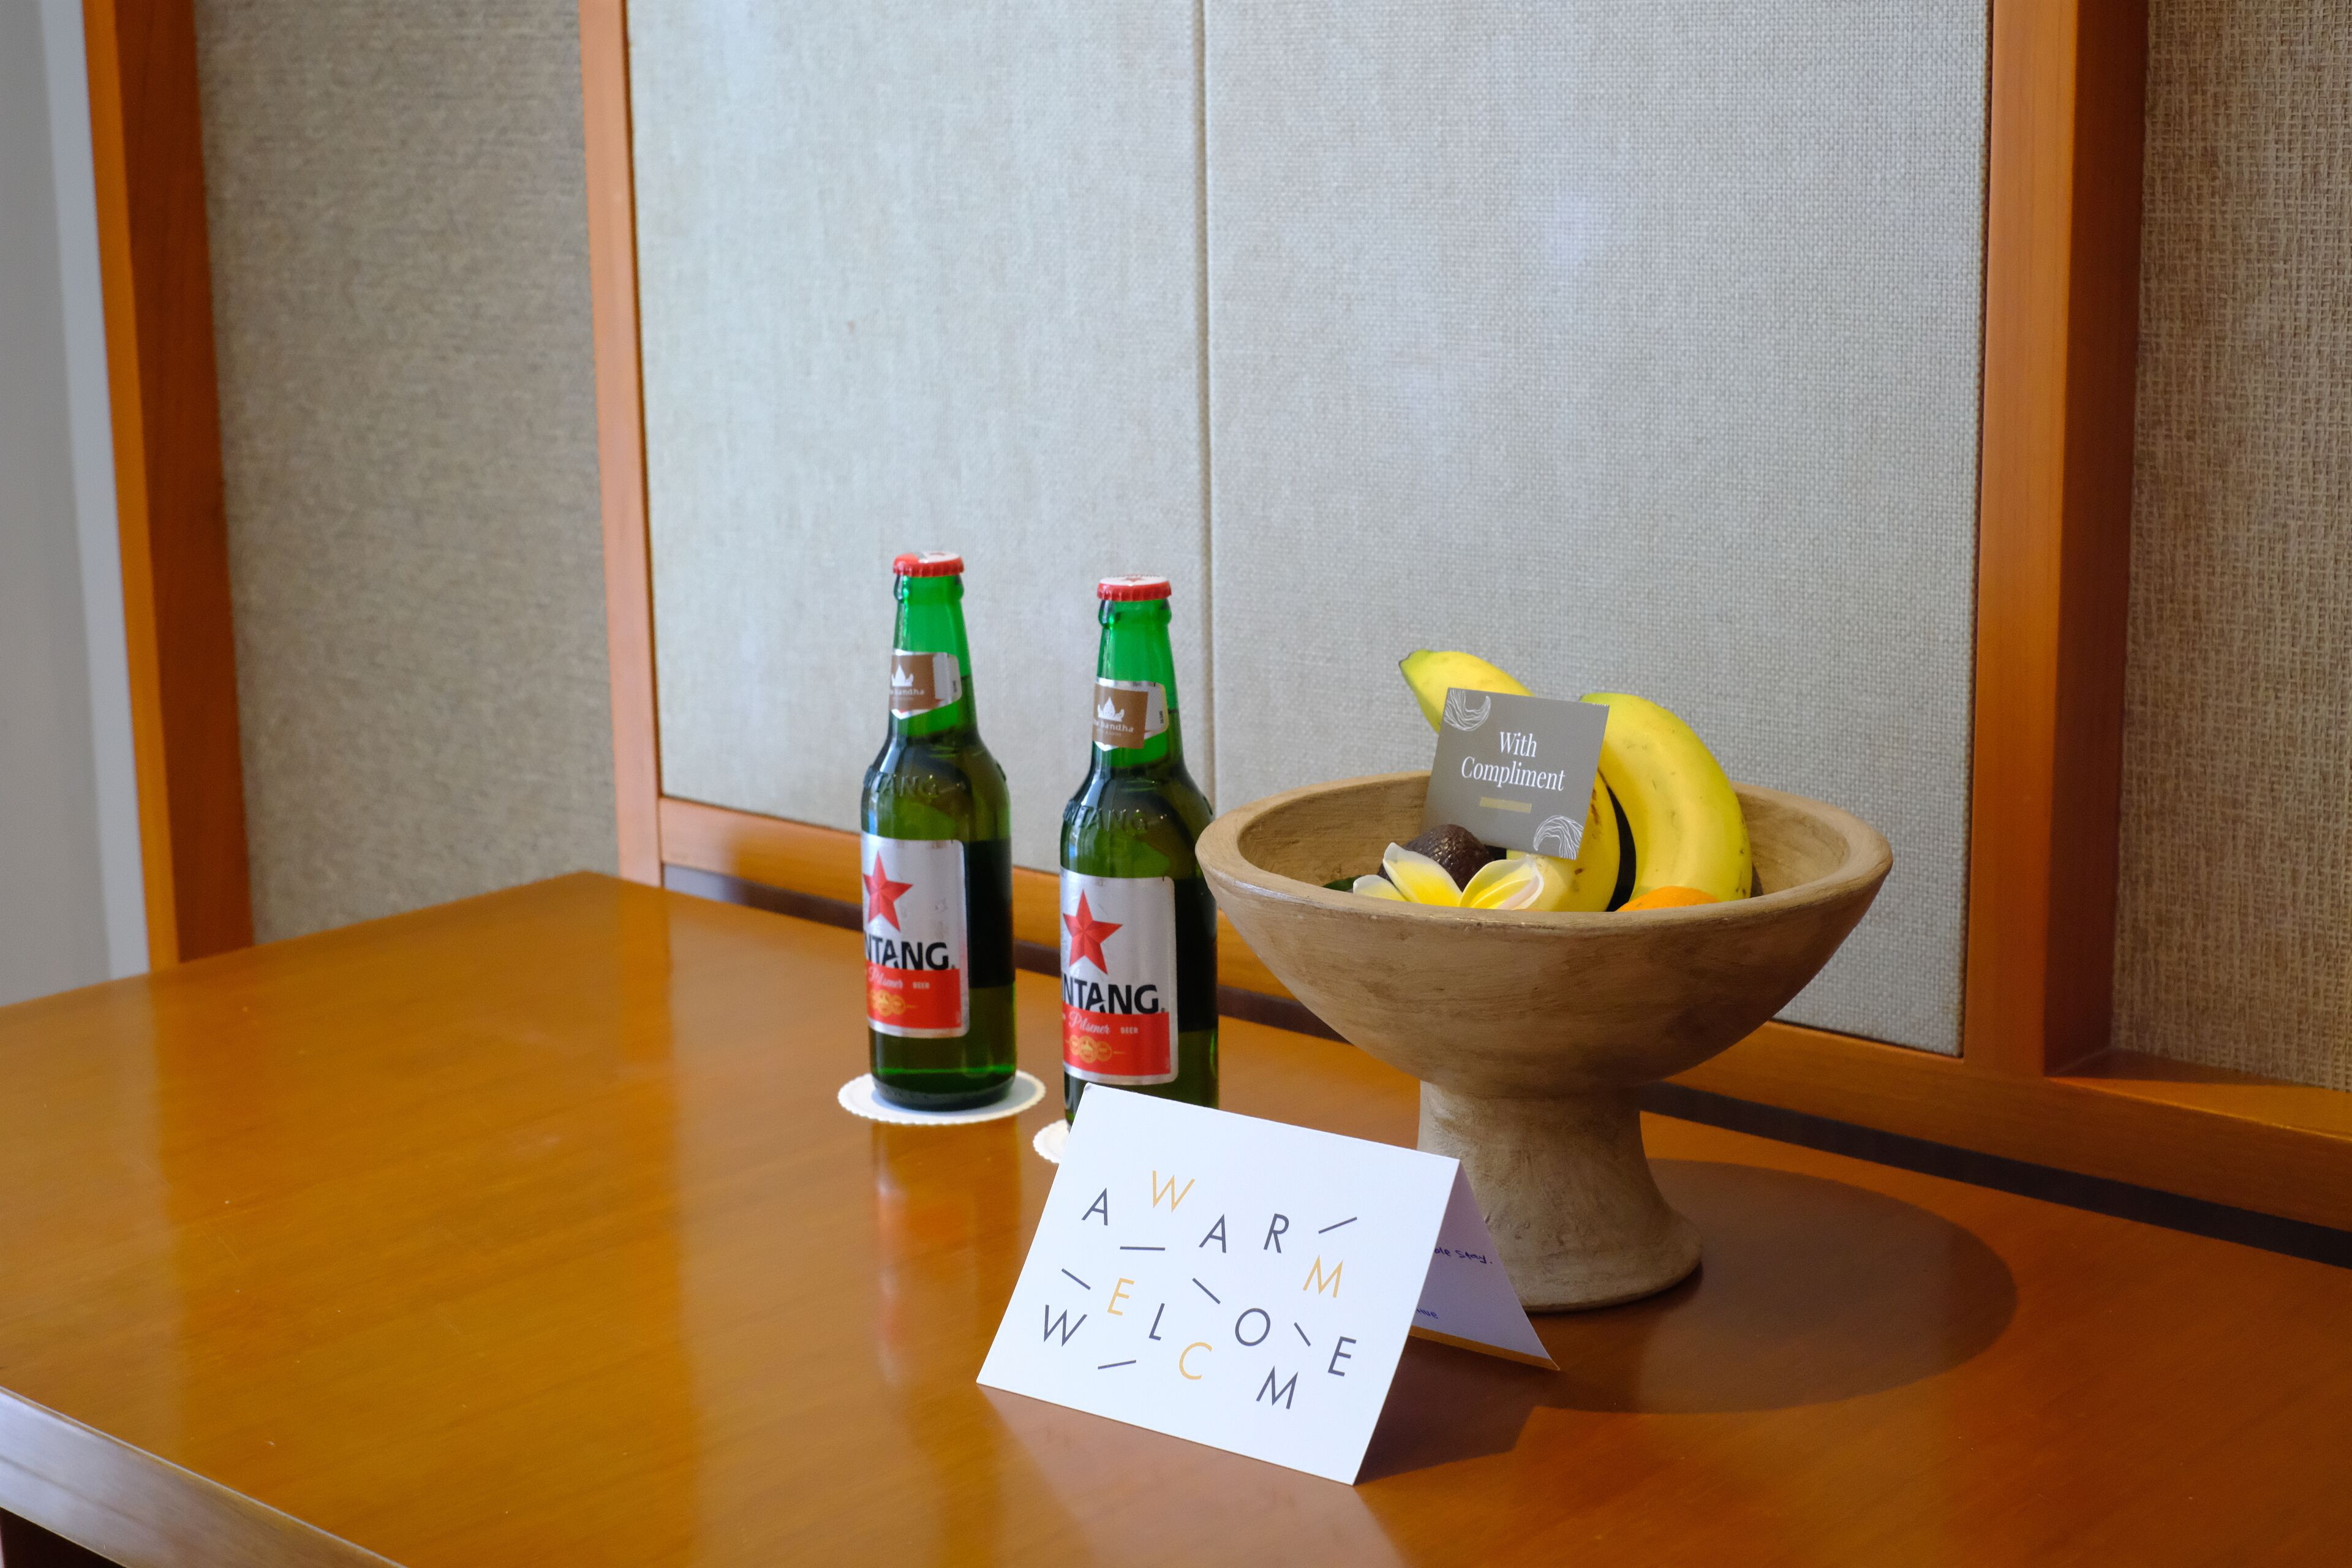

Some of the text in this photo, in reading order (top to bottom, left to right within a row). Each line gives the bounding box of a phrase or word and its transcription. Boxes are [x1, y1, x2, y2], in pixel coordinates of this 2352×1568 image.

[1499, 731, 1537, 758] With
[1461, 756, 1566, 791] Compliment
[1082, 1187, 1108, 1226] A
